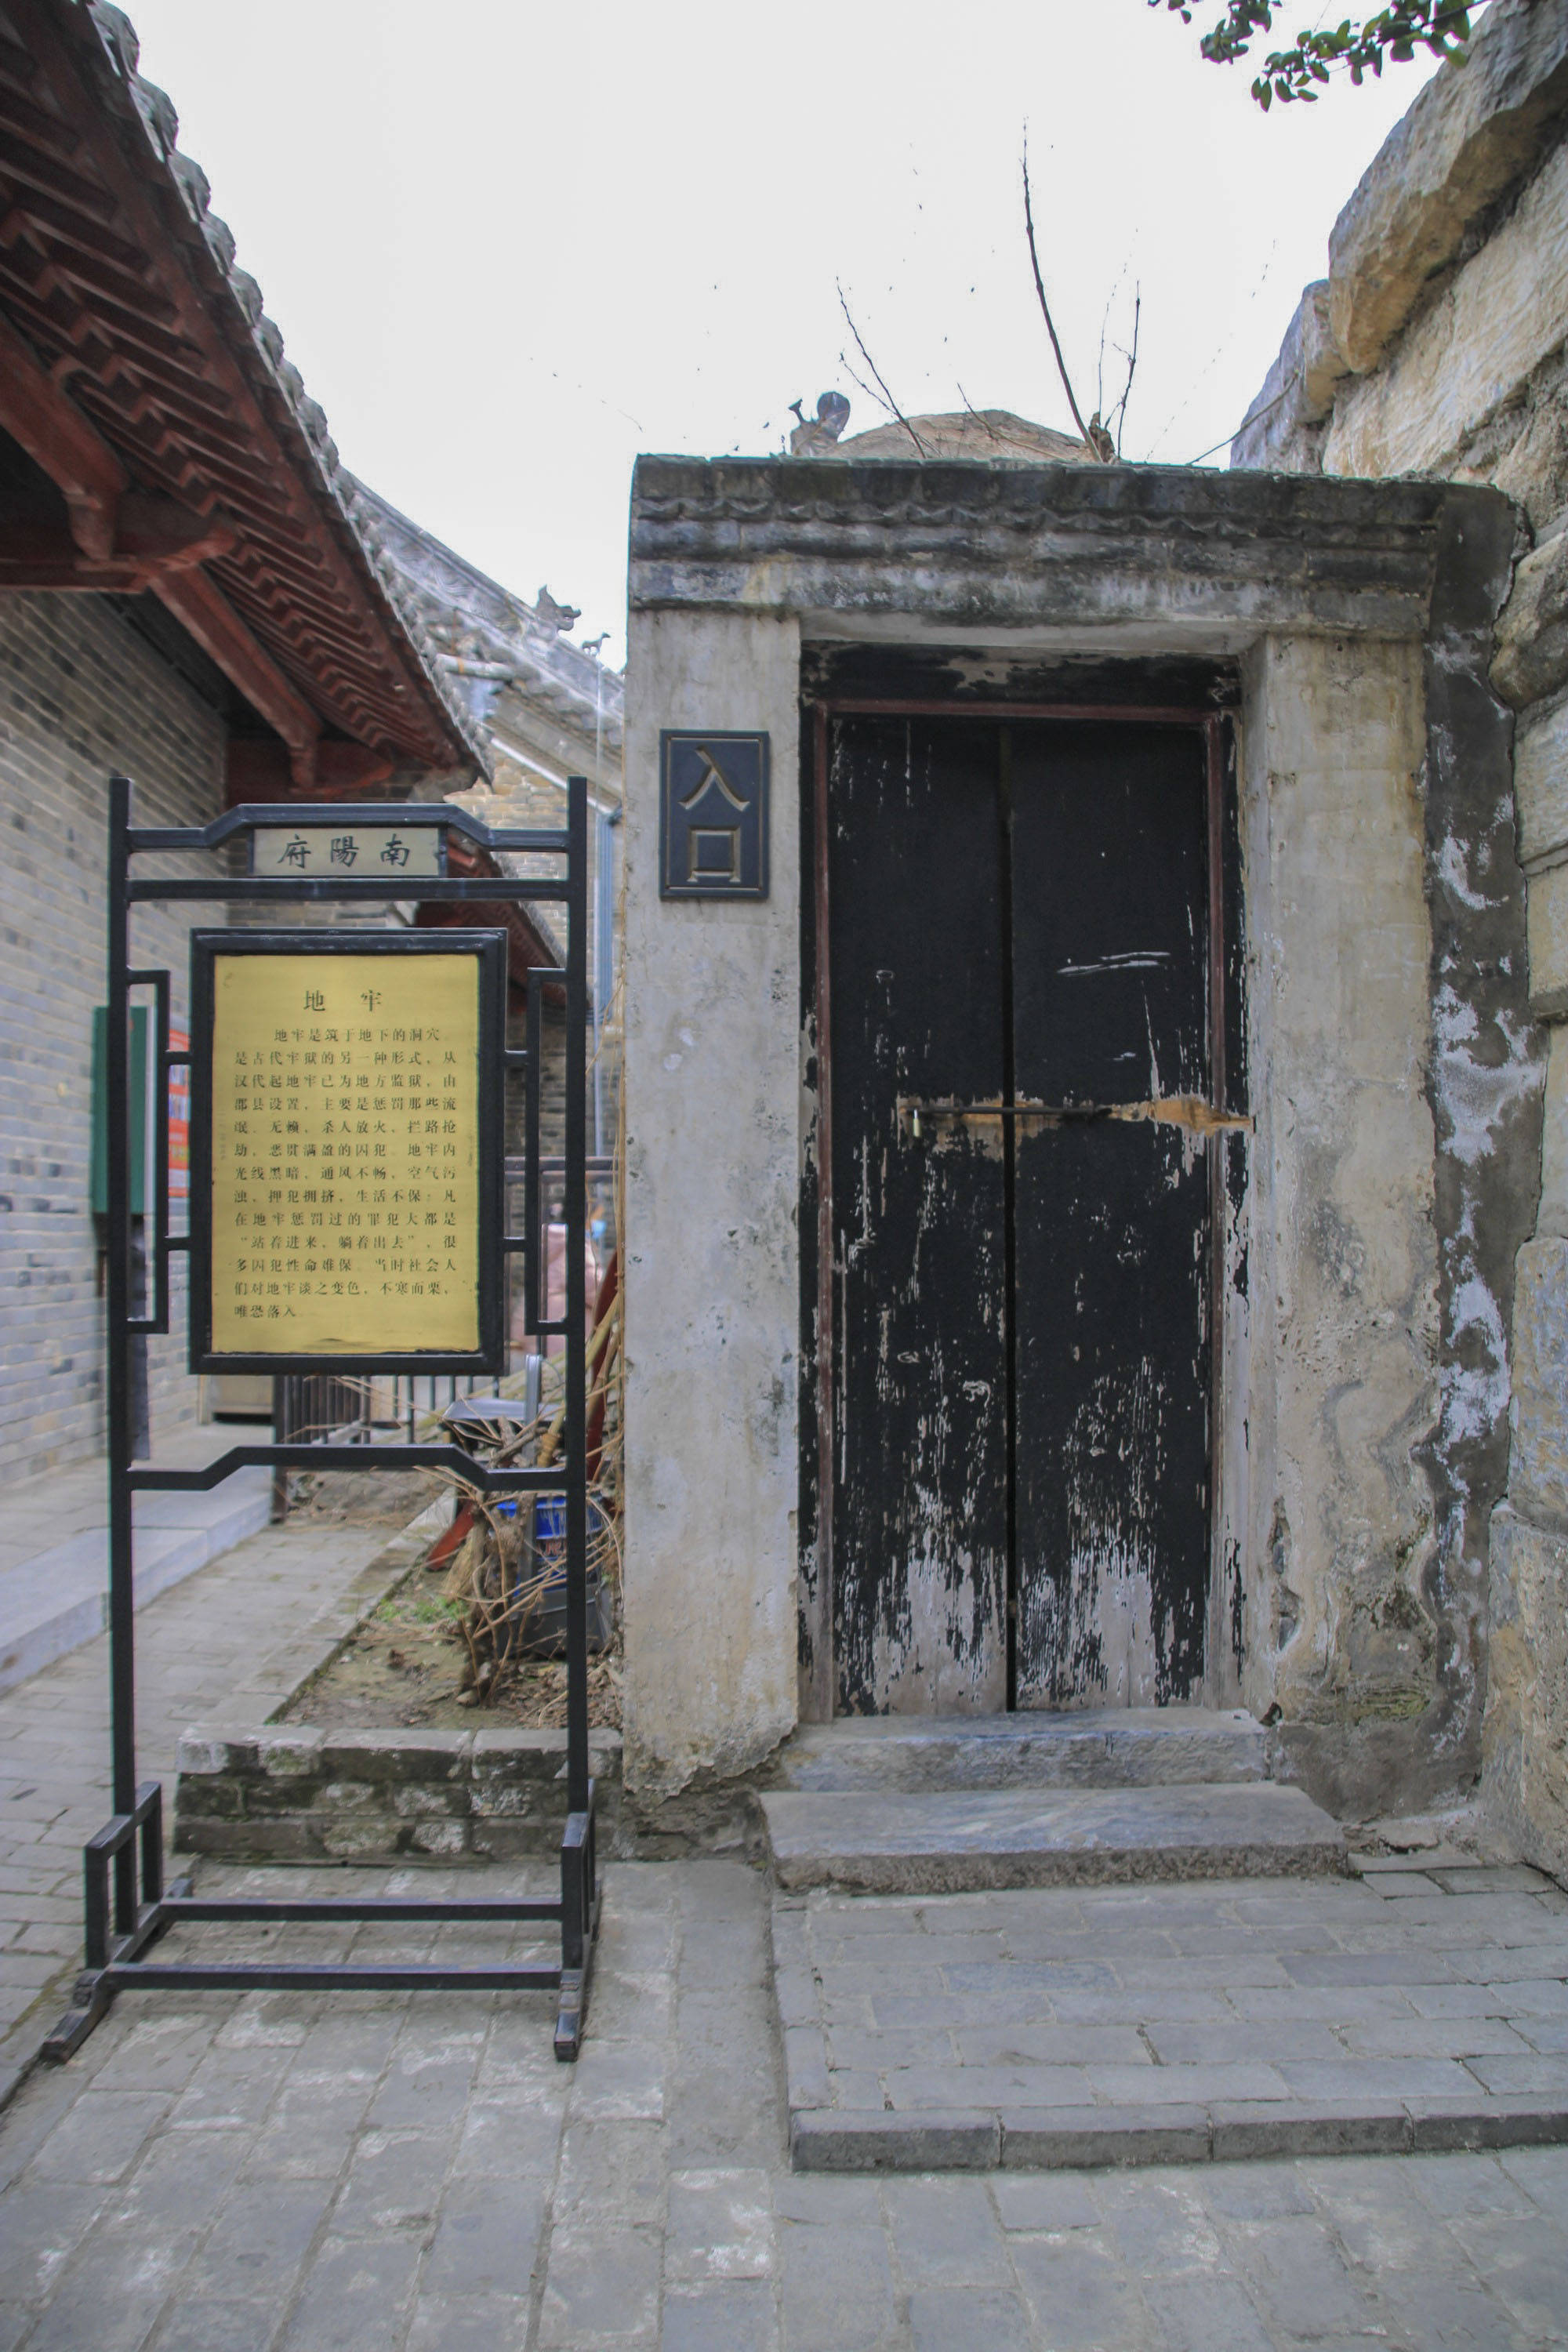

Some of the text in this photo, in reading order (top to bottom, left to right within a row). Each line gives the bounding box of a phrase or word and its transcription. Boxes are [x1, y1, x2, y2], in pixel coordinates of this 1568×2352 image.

[677, 745, 750, 883] 入口
[277, 833, 410, 868] 南陽府
[303, 989, 383, 1012] 地牢
[234, 1212, 457, 1226] 在地牢惩罚过的罪犯大都是
